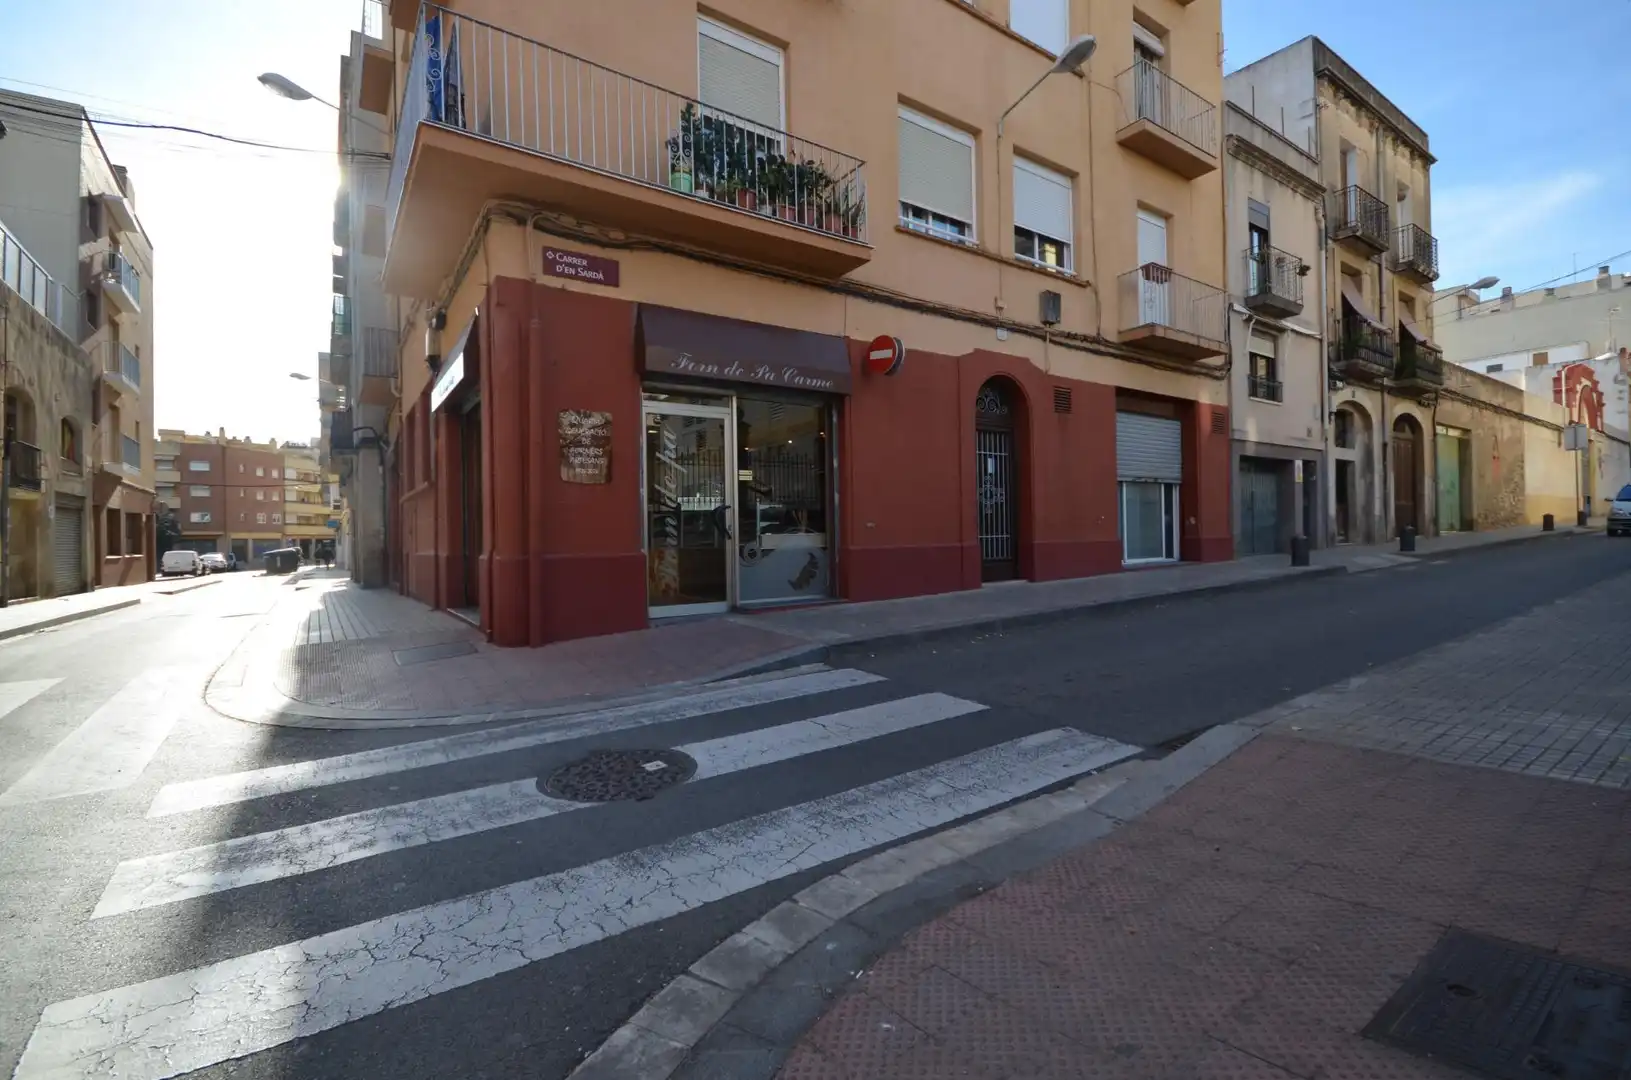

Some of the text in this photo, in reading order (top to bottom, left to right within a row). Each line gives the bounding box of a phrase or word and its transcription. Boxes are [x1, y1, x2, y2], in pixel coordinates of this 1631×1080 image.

[556, 252, 588, 266] CARRER
[556, 264, 576, 275] D'EN
[724, 361, 744, 377] de
